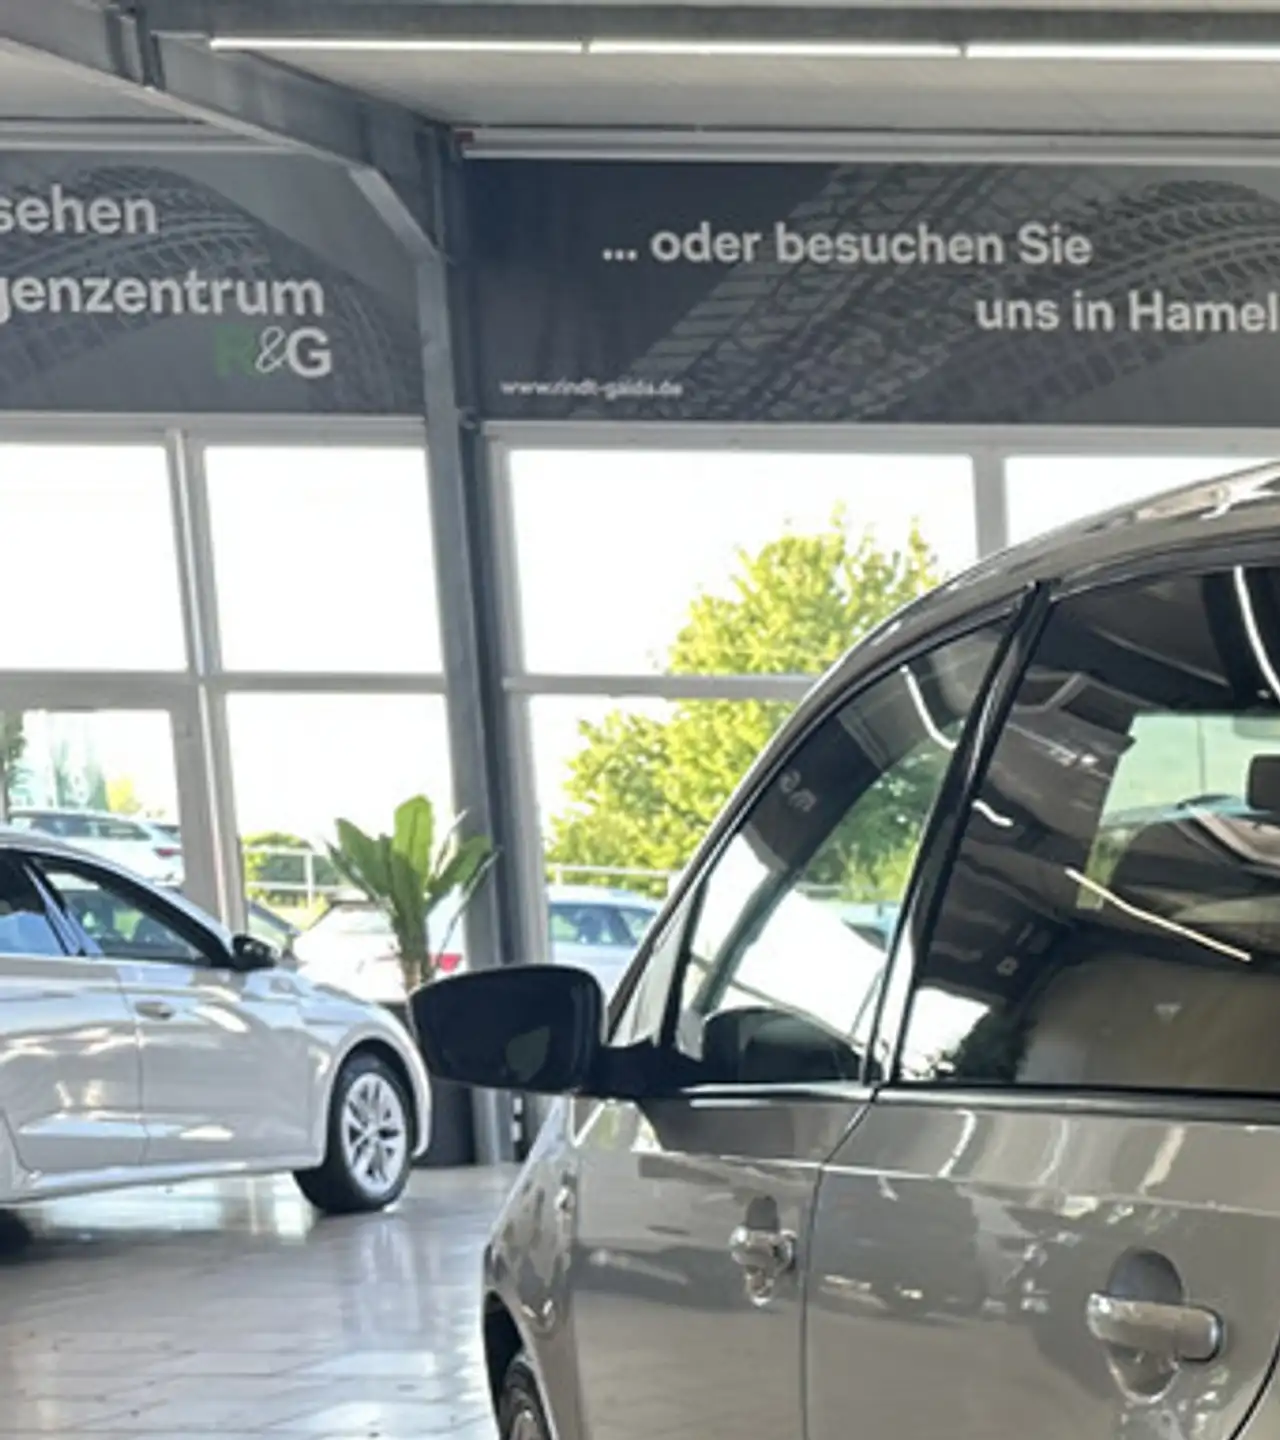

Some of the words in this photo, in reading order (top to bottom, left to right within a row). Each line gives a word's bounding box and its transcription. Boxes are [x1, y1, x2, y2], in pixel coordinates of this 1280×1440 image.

[651, 222, 762, 264] oder
[776, 223, 1004, 264] besuchen
[1017, 223, 1093, 264] Sie
[0, 270, 325, 322] enzentrum
[975, 298, 1060, 332] uns
[1073, 291, 1114, 332] in
[214, 325, 333, 379] R&G
